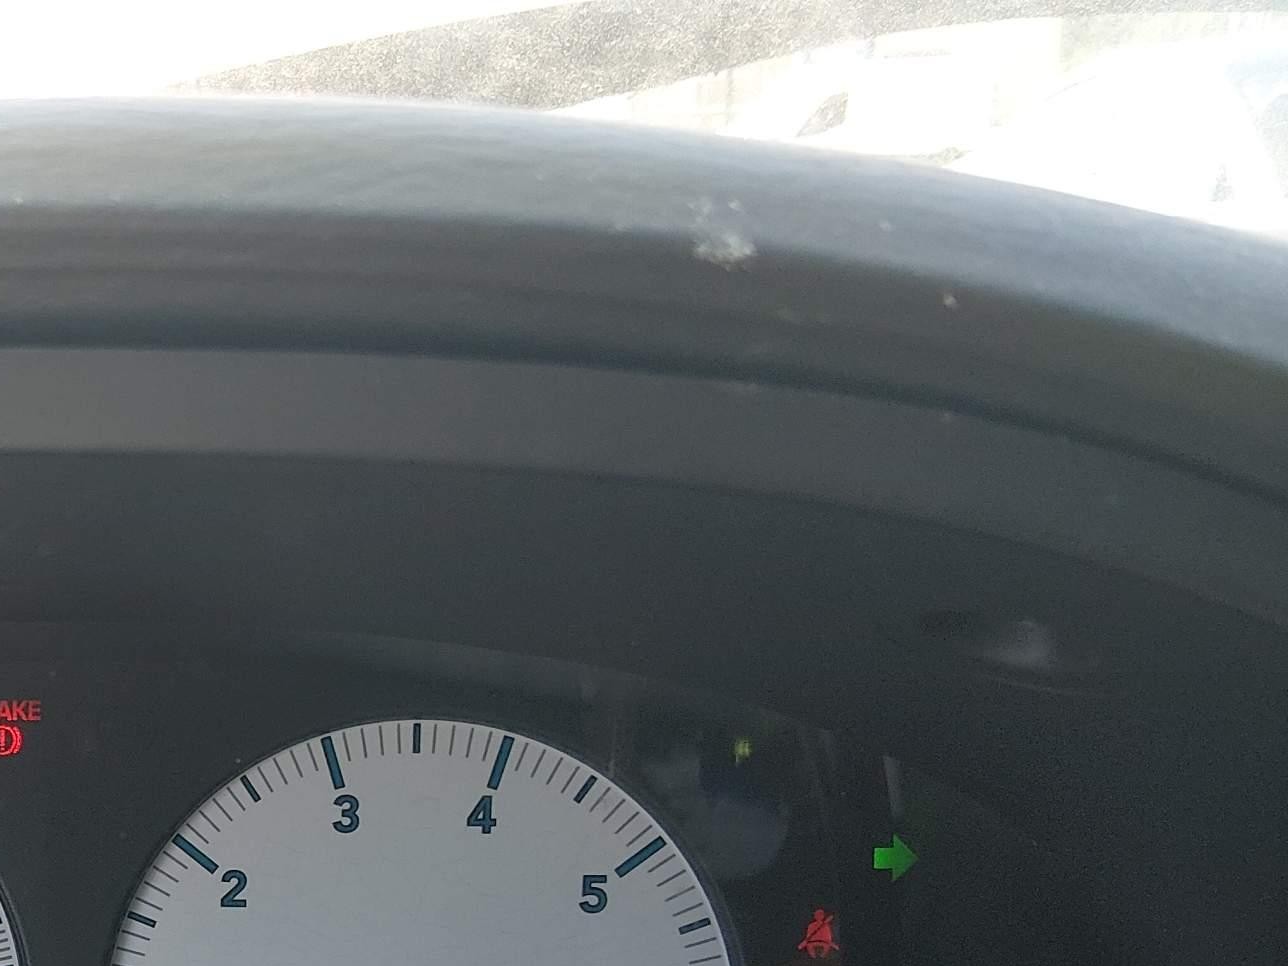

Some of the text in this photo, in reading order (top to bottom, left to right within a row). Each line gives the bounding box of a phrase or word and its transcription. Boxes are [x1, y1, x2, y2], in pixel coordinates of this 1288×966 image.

[332, 795, 359, 833] 3
[467, 795, 496, 834] 4
[221, 870, 247, 907] 2
[579, 875, 607, 913] 5
